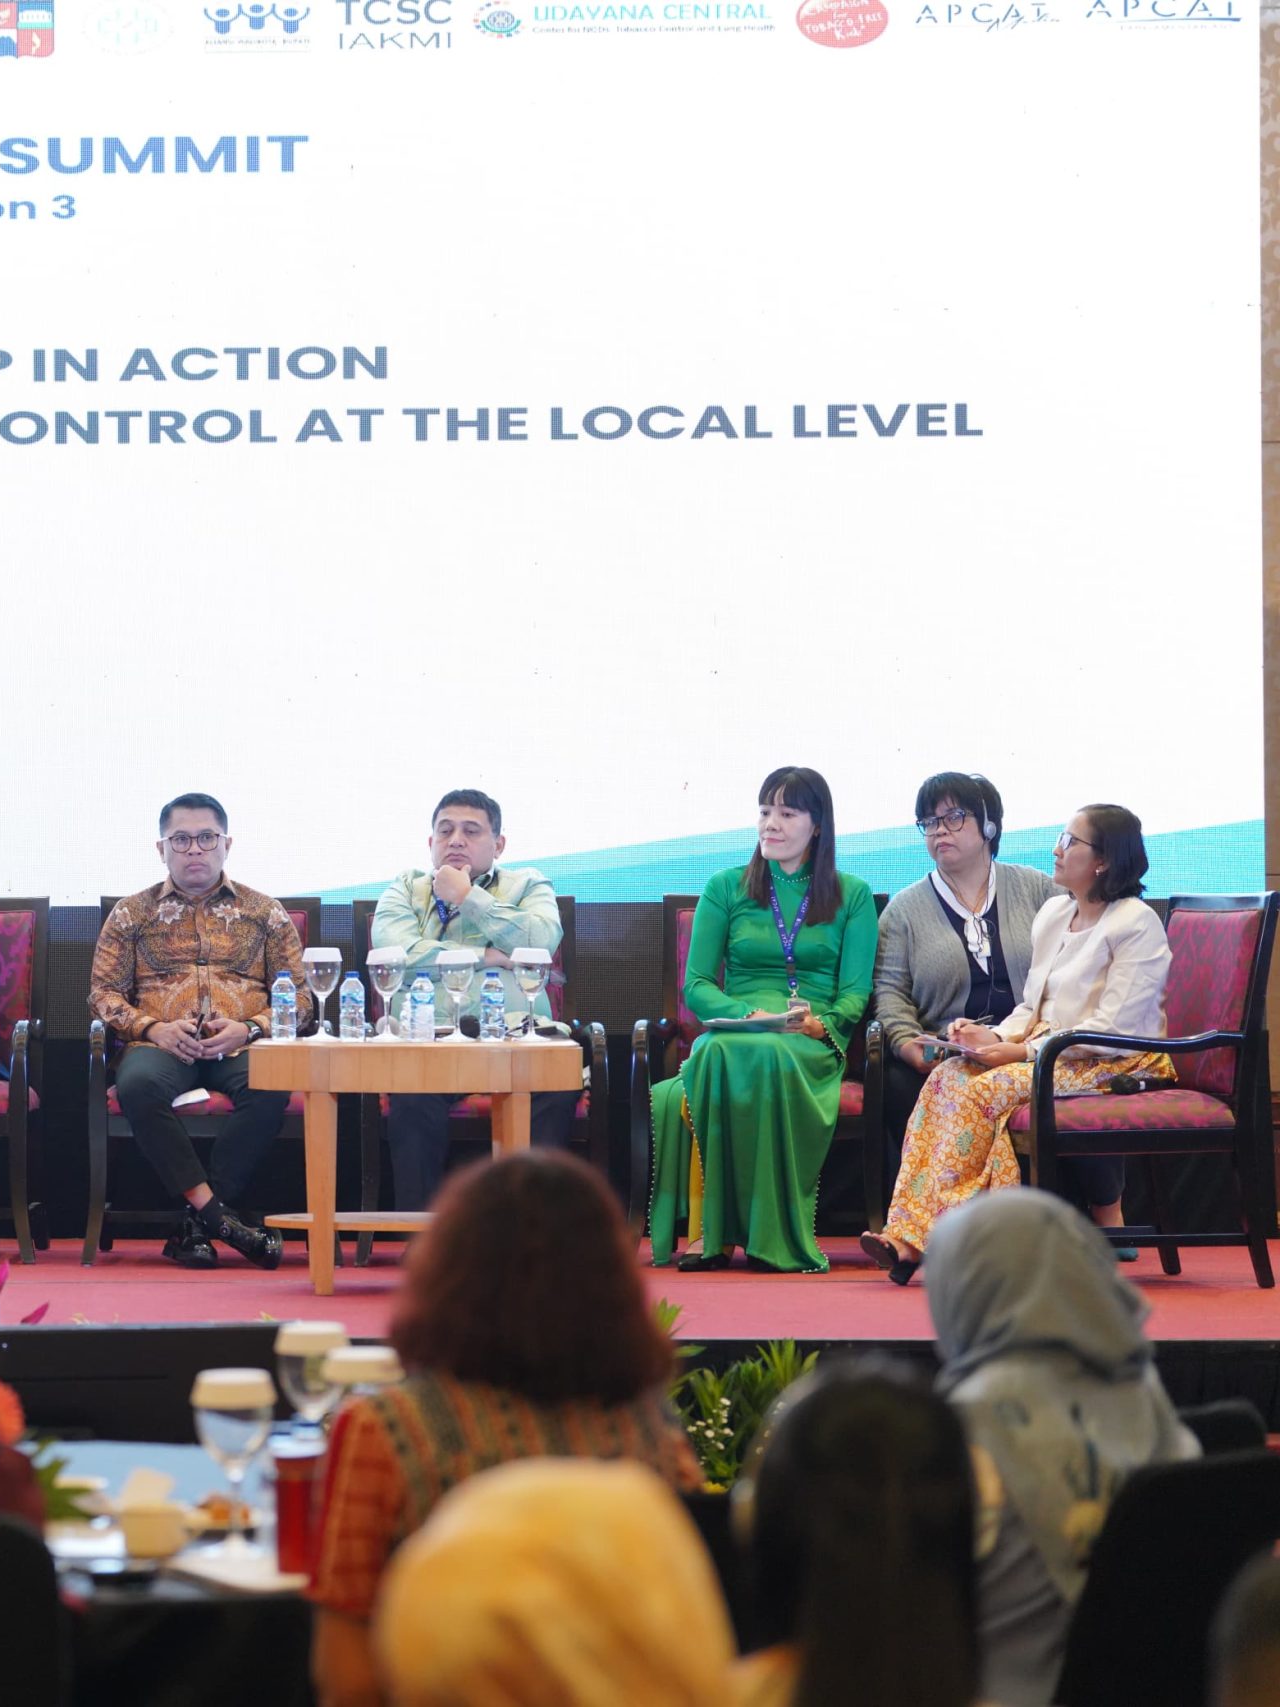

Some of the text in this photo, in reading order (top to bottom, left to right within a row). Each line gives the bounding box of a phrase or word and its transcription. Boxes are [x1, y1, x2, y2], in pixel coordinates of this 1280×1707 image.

[335, 0, 452, 25] TCSC
[533, 4, 773, 21] UDAYANA CENTRAL
[915, 3, 1047, 24] APCAT
[339, 32, 452, 50] IAKMI
[0, 135, 308, 174] SUMMIT
[52, 194, 76, 219] 3
[33, 348, 98, 382] IN
[119, 346, 388, 382] ACTION
[296, 408, 385, 443] AT
[402, 407, 528, 442] THE
[550, 405, 773, 441] LOCAL
[793, 403, 984, 438] LEVEL
